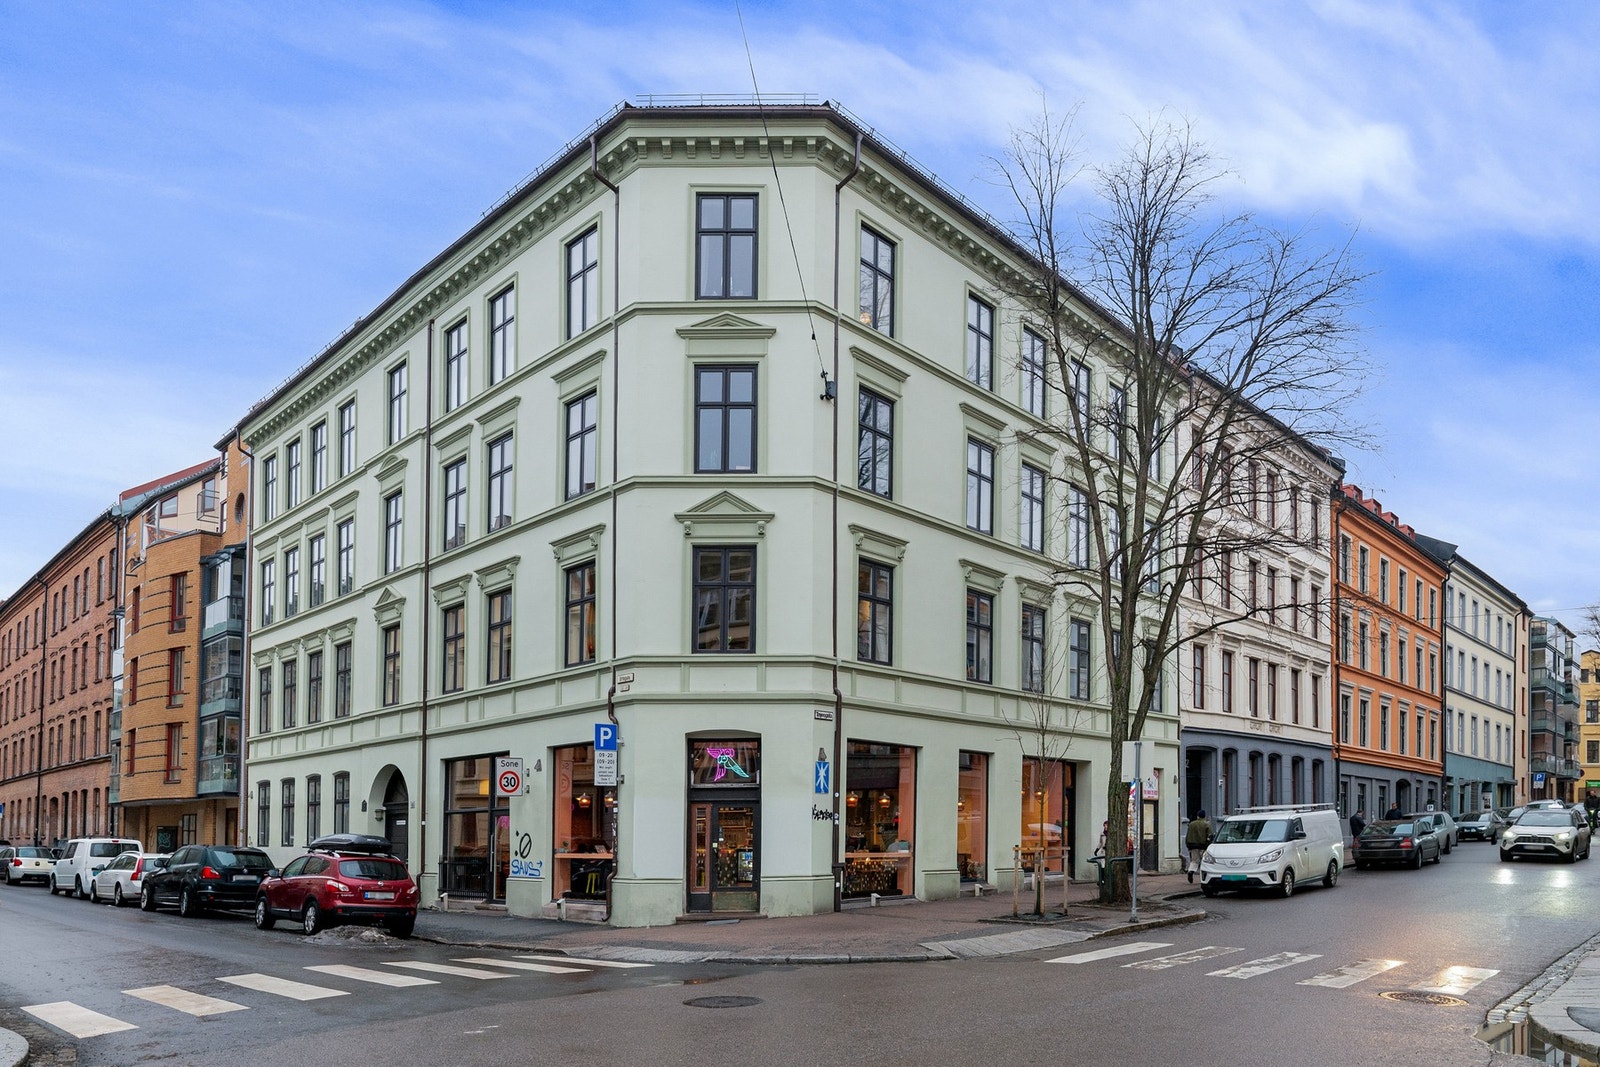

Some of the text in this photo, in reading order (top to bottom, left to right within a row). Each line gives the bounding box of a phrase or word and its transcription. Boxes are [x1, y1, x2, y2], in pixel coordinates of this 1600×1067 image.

[600, 728, 612, 746] P
[500, 760, 518, 768] Sone
[502, 776, 516, 788] 30
